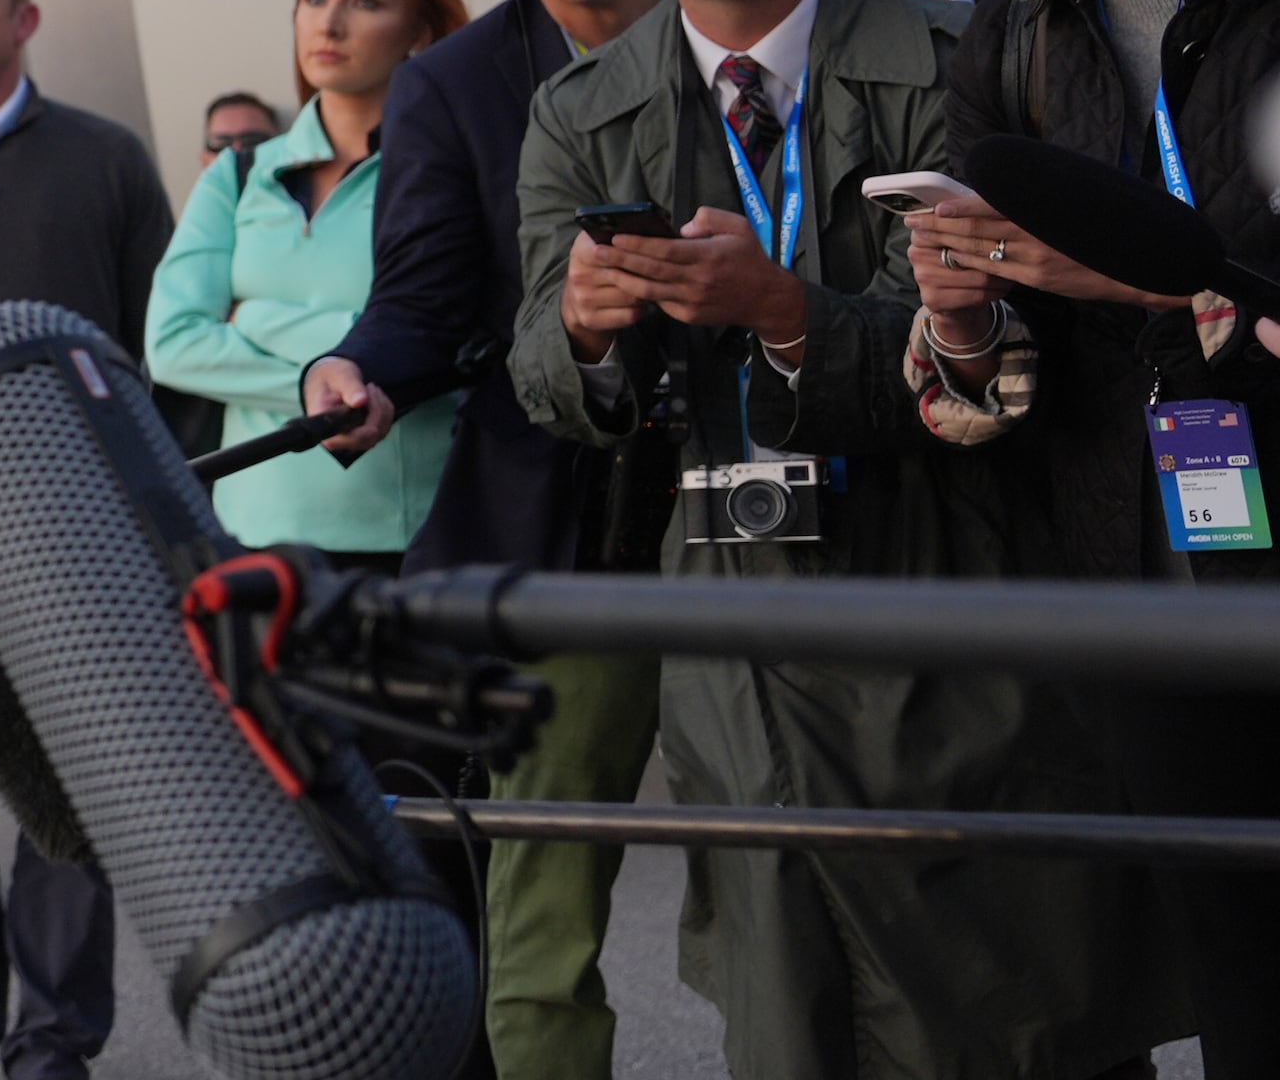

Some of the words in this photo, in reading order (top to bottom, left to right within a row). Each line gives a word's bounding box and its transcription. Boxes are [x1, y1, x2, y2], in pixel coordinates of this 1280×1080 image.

[1166, 151, 1182, 185] IRISH
[747, 192, 765, 225] OPEN
[783, 192, 799, 224] OPEN
[1185, 456, 1203, 465] Zone
[1204, 455, 1210, 463] A
[1189, 510, 1198, 523] 5
[1203, 509, 1212, 522] 6
[1232, 533, 1254, 541] OPEN
